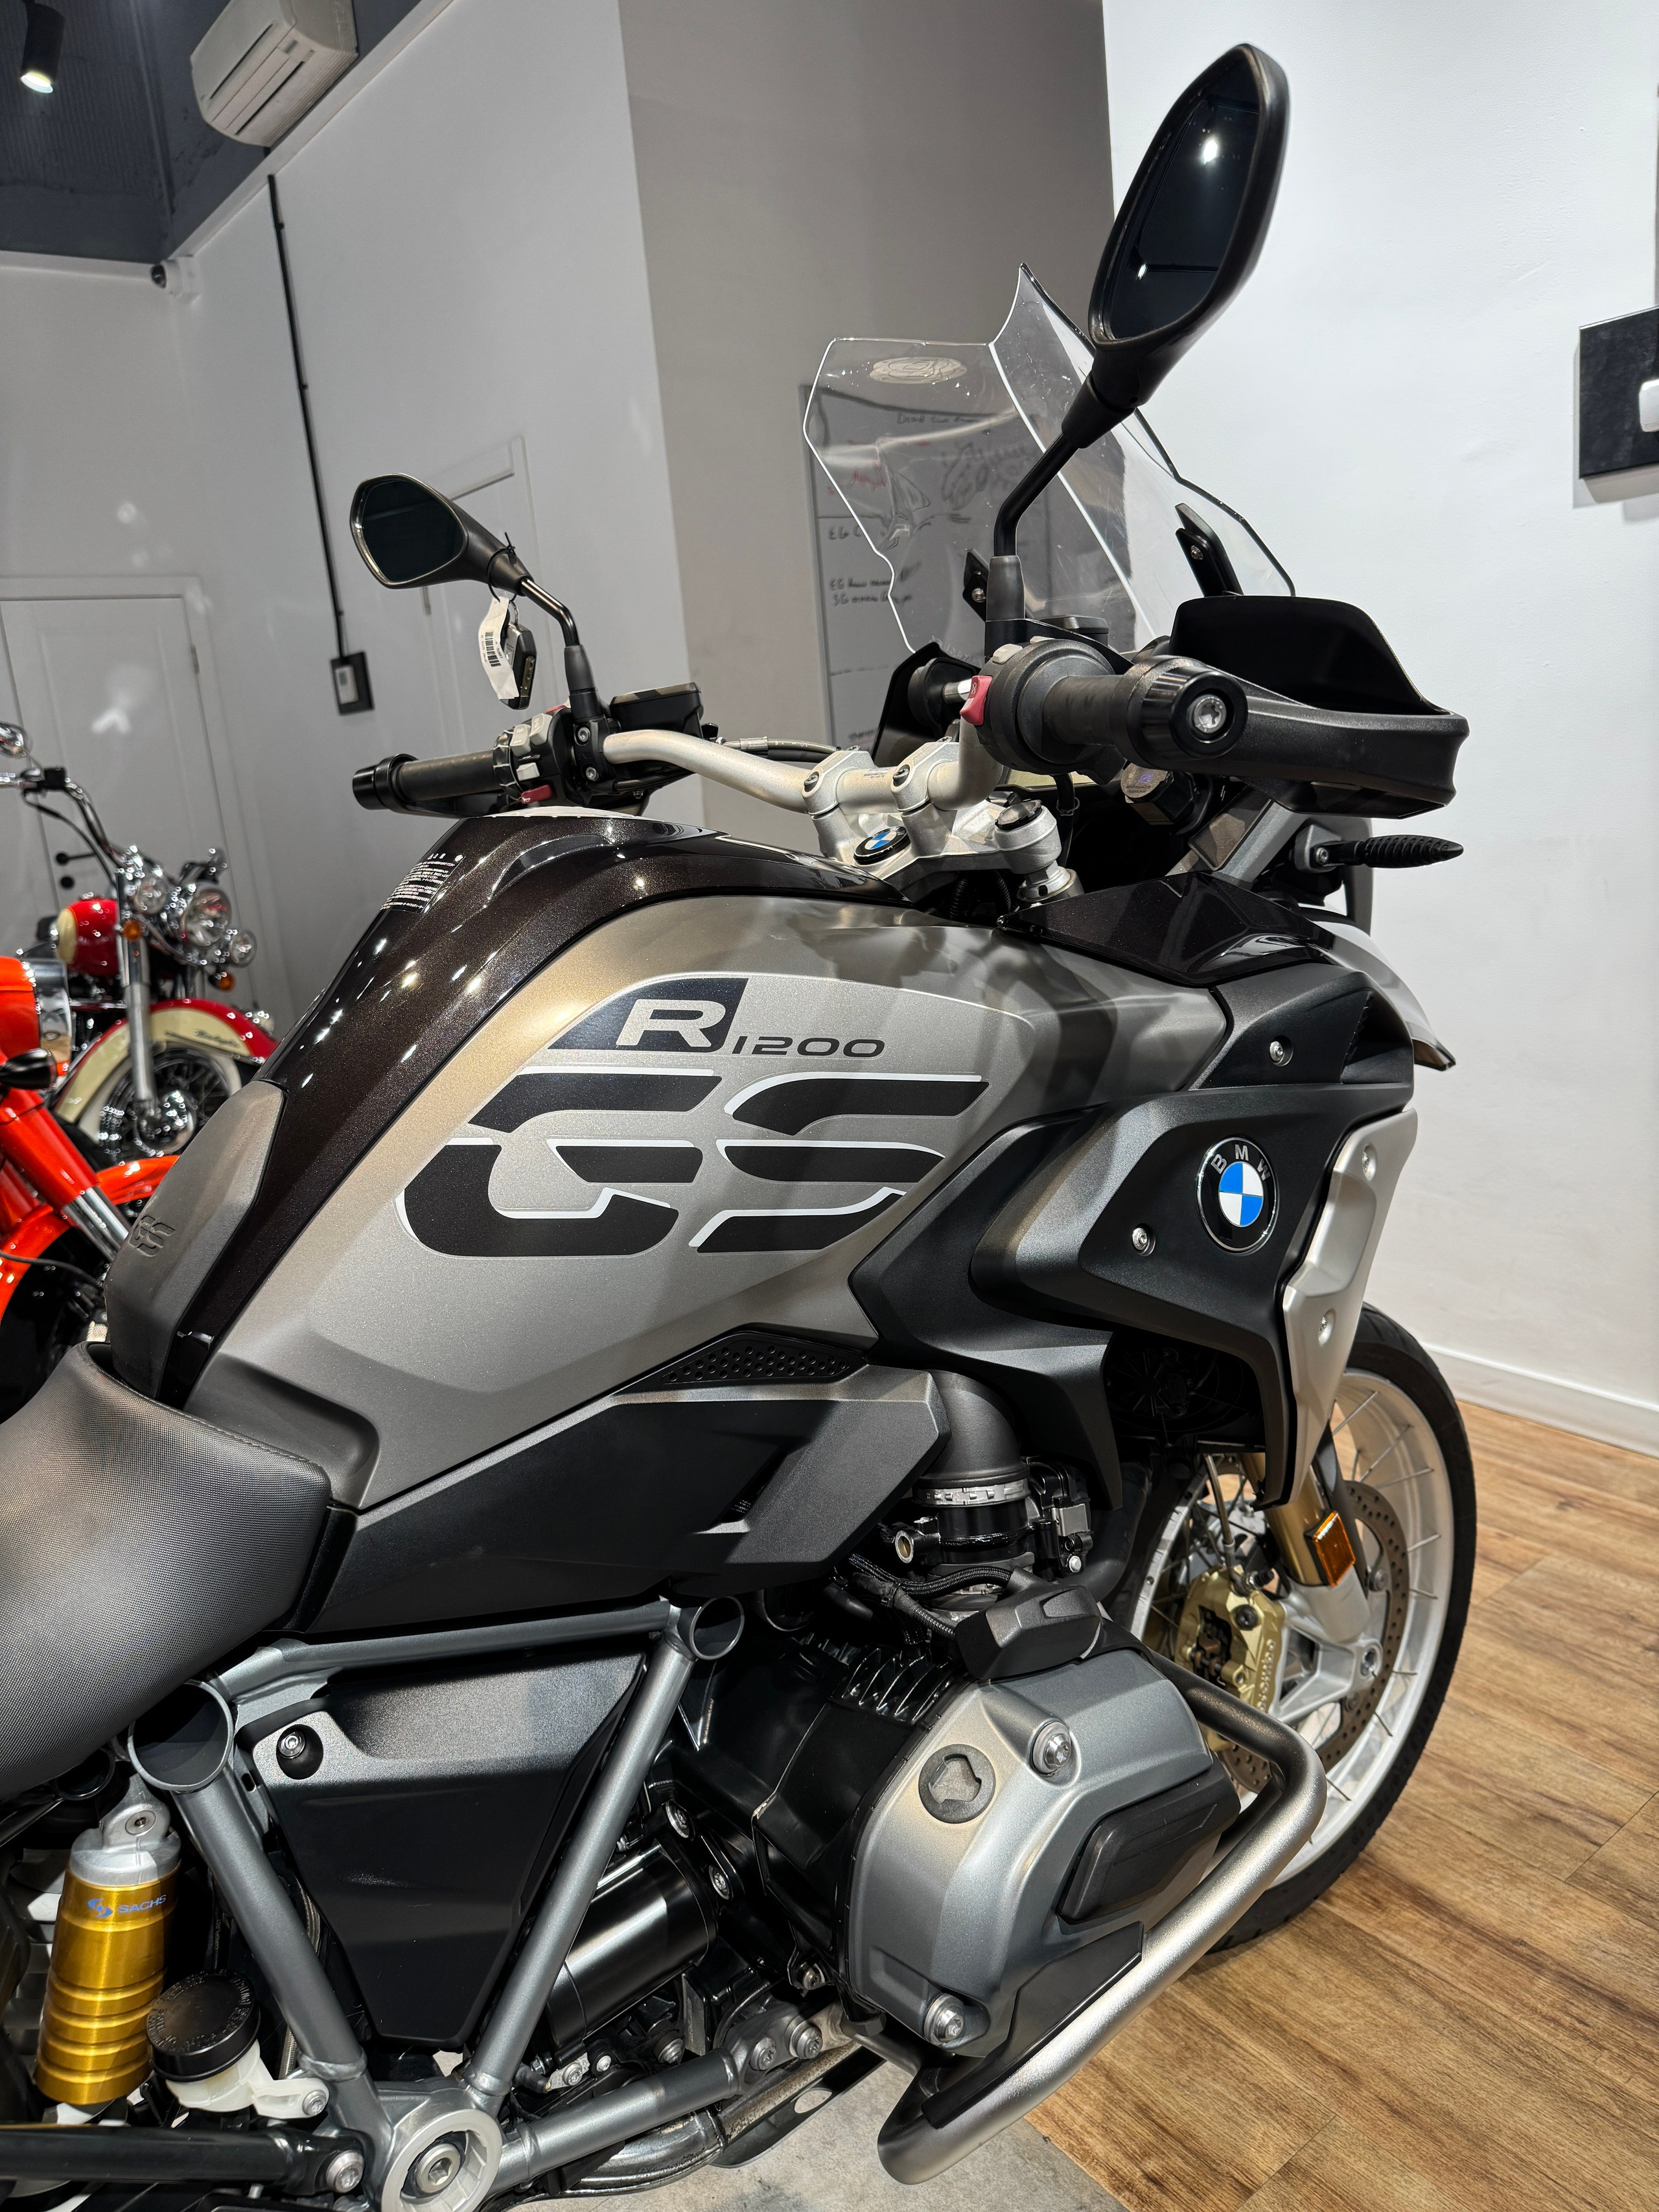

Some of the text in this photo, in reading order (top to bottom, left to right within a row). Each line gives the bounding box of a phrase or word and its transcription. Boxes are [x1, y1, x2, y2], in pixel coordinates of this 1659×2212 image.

[616, 998, 886, 1058] R 1200
[395, 1065, 990, 1259] GS
[1210, 1144, 1271, 1181] BMW
[117, 1894, 167, 1914] SACHS
